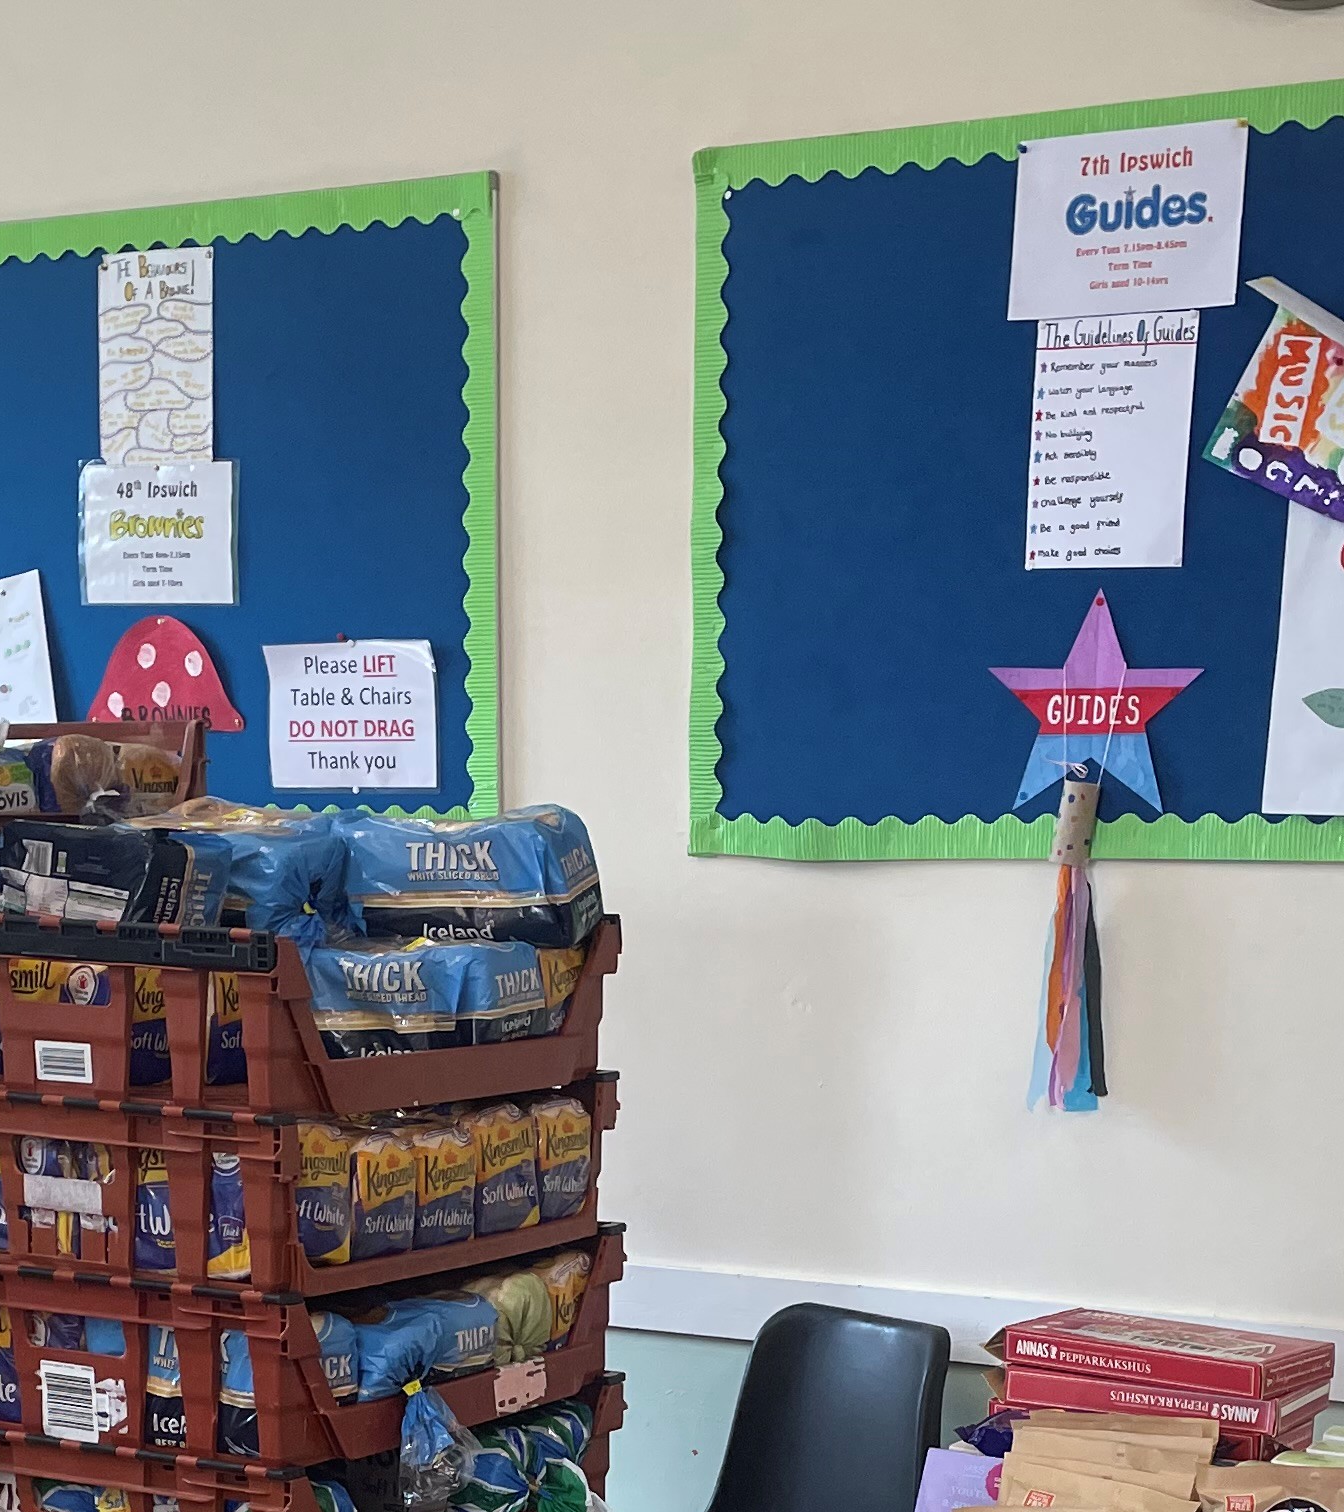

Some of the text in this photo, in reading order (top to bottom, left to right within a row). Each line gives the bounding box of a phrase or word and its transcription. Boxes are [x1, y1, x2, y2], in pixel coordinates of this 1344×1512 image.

[1081, 146, 1193, 176] 7th Ipswich
[1045, 316, 1196, 356] The Guidelines Of Guides
[1269, 339, 1314, 442] MUSIC
[1045, 431, 1057, 439] No
[147, 481, 198, 498] Ipswich
[1044, 471, 1111, 485] Be responsible
[109, 508, 205, 541] Brownies
[1040, 524, 1052, 533] Be
[1070, 522, 1090, 534] good
[304, 655, 396, 674] Please LIFT
[290, 686, 412, 706] Table & Chairs
[1047, 694, 1140, 727] GUIDES
[289, 719, 415, 738] DO NOT DRAG
[308, 751, 396, 774] Thank you
[406, 840, 496, 873] THICK
[561, 845, 592, 878] THICK
[407, 870, 436, 882] WHITE
[423, 922, 496, 940] Iceland
[339, 958, 427, 991] THICK
[495, 967, 539, 997] THICK
[480, 1126, 534, 1172] Kingsmill
[482, 1186, 505, 1206] Soft
[314, 1207, 346, 1227] White
[1015, 1338, 1152, 1374] ANNAS PEPPARKAKSHUS
[1110, 1389, 1259, 1423] PEPPARKAKSHUS ANNAS
